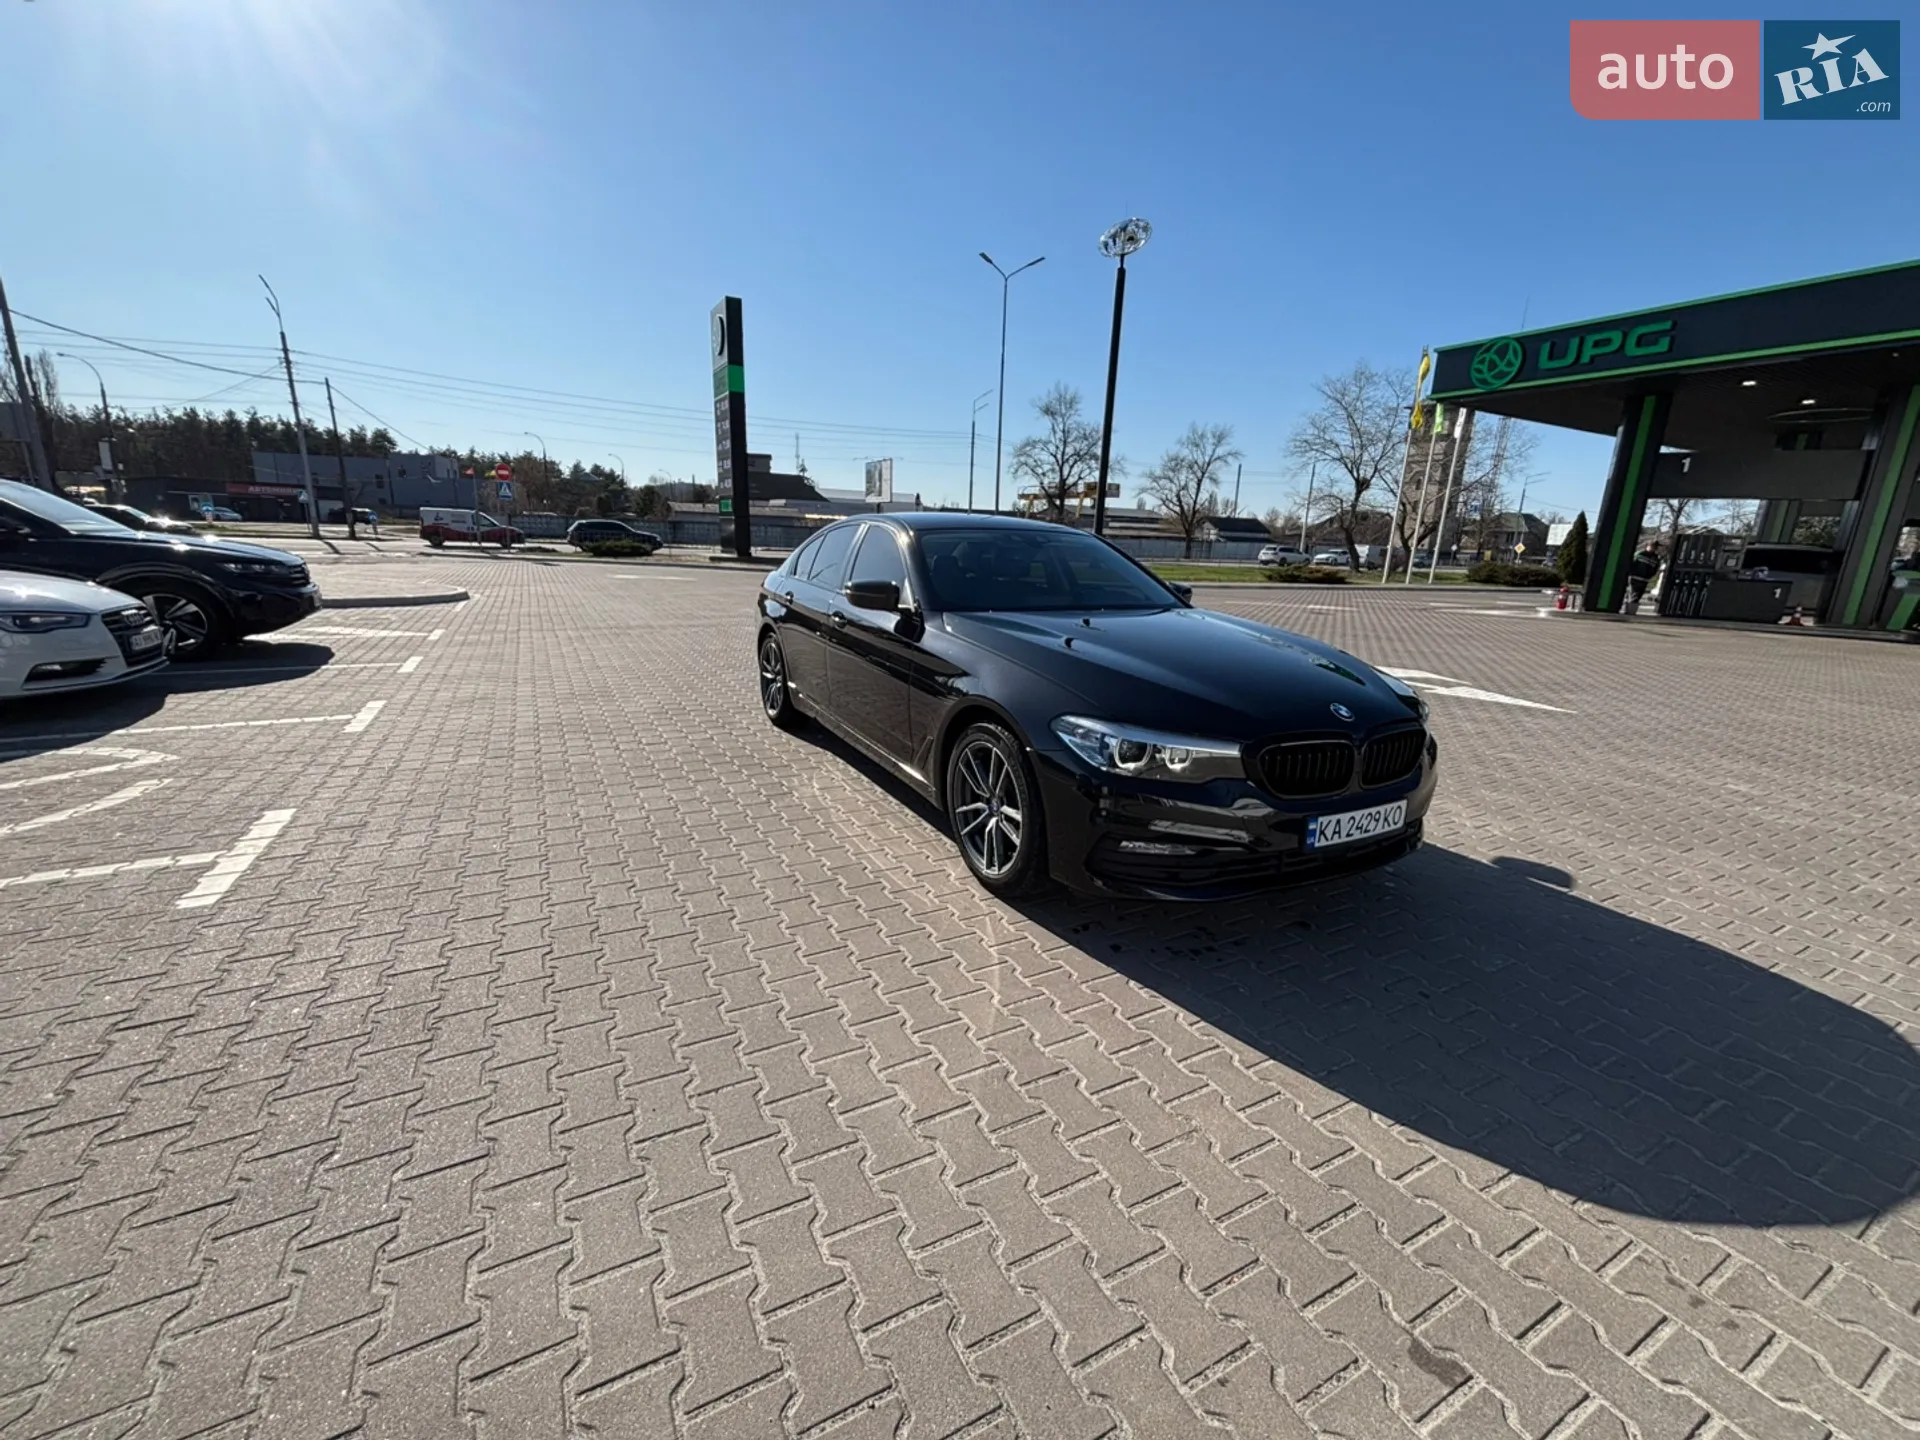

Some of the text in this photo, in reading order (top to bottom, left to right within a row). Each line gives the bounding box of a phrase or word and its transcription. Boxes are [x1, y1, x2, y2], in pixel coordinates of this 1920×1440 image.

[1539, 321, 1672, 369] UPG
[1681, 457, 1691, 473] 1
[1774, 588, 1782, 599] 1
[1318, 806, 1402, 843] KA 2429 KO
